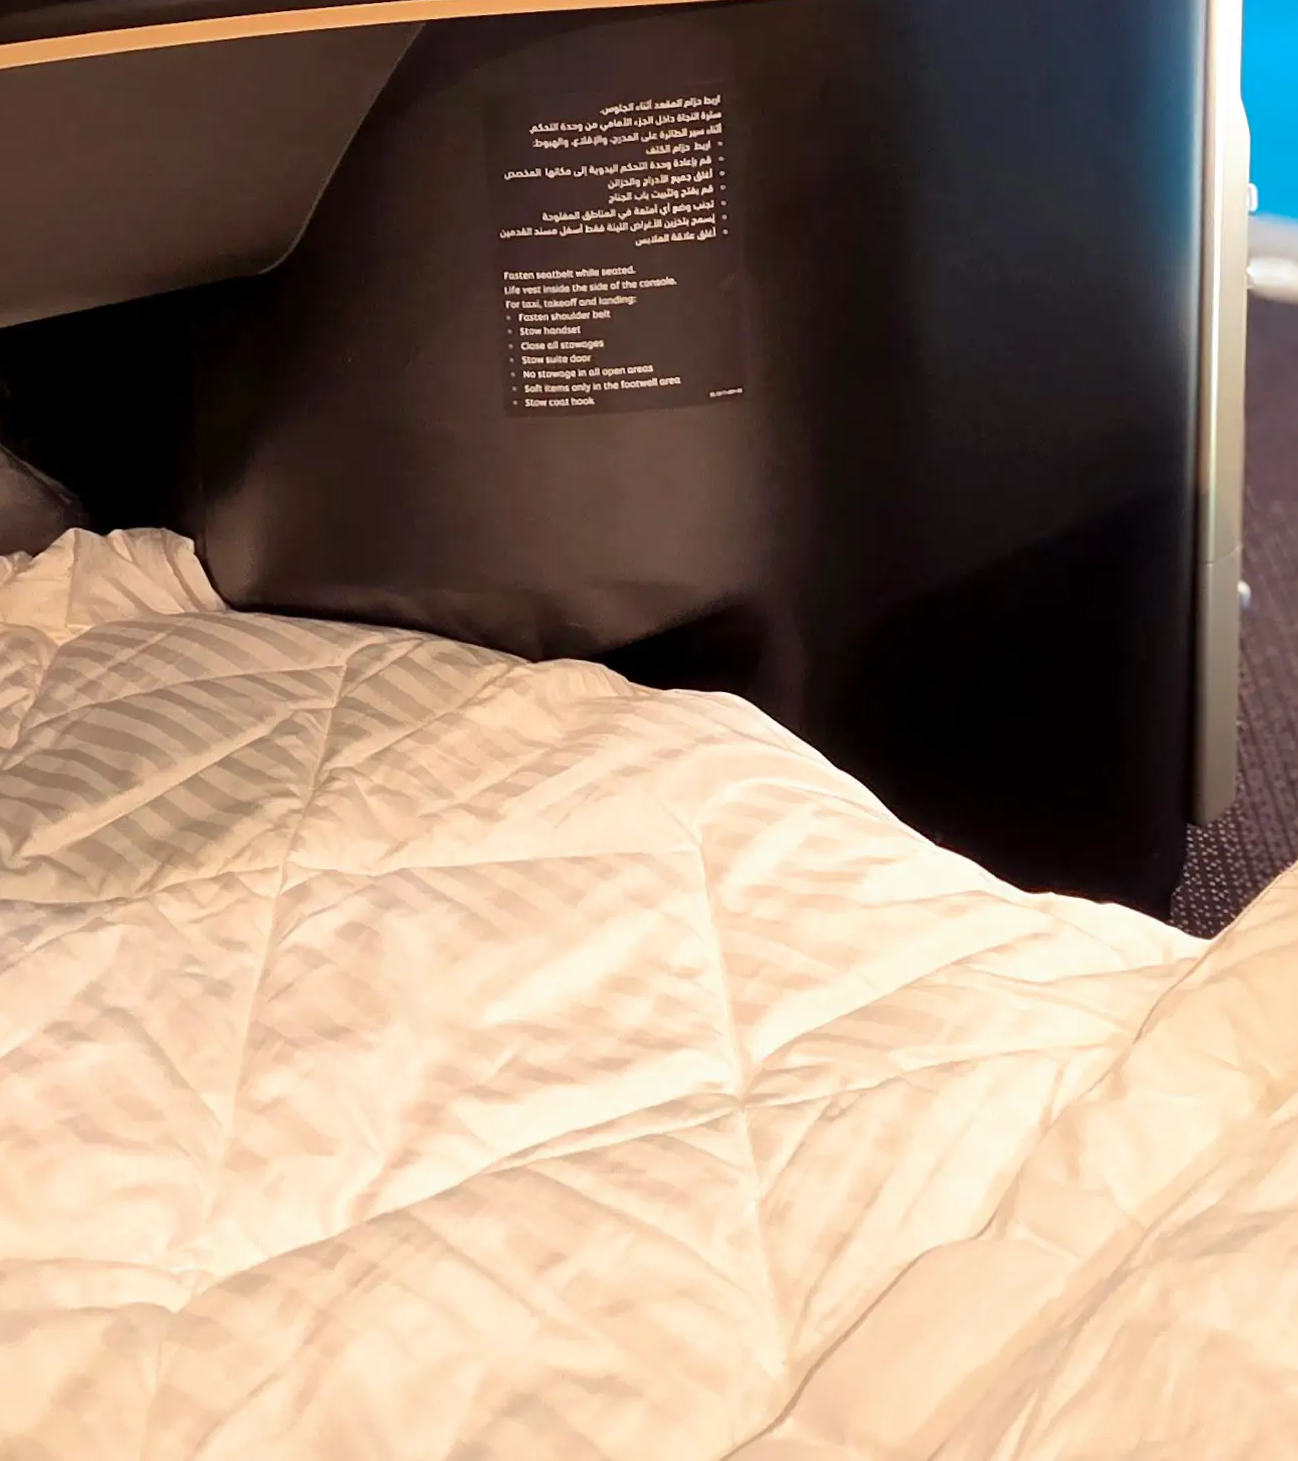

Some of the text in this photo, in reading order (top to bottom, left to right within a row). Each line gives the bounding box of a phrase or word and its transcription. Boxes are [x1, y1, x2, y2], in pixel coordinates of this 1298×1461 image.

[654, 99, 683, 109] المقعد
[684, 98, 702, 108] حزام
[634, 116, 653, 127] الجزء
[655, 115, 675, 126] داخل
[677, 112, 699, 122] النجاة
[560, 123, 583, 132] وحدة
[585, 123, 598, 131] من
[600, 118, 632, 131] الأمامي
[641, 131, 658, 142] على
[659, 128, 687, 140] الطائرة
[689, 129, 704, 138] سير
[672, 144, 690, 154] حزام
[650, 161, 671, 170] وحدة
[699, 155, 712, 166] قم
[545, 167, 571, 178] مكانها
[573, 166, 587, 177] إلى
[589, 164, 618, 175] اليدوية
[620, 162, 648, 174] التحكم
[504, 168, 541, 180] المخصص
[608, 168, 713, 189] أغلق جميع الأدراج والخزائن
[634, 191, 649, 200] باب
[681, 187, 699, 198] بفتح
[702, 185, 714, 195] قم
[542, 200, 714, 222] تجنب وضع أي أمتعة في المناطق المفتوحة
[585, 224, 605, 233] فقط
[630, 219, 662, 232] الأغراض
[664, 217, 689, 229] بتخزين
[500, 227, 532, 238] القدمين
[534, 227, 558, 235] مسند
[559, 223, 583, 236] أسفل
[635, 227, 716, 246] أغلق علاقة الملابس
[504, 266, 636, 280] Fasten seatbelt while seated.
[504, 276, 677, 295] Life vest inside the side of the console.
[506, 296, 636, 309] For taxi, takeoff and landing:
[519, 310, 611, 322] Fasten shoulder belt
[520, 326, 581, 335] Stow handset
[521, 340, 604, 350] Close all stowages
[522, 355, 591, 365] Stow suite door
[538, 370, 576, 379] stowage
[589, 368, 600, 376] all
[602, 367, 626, 377] open
[627, 365, 653, 374] areas
[524, 384, 542, 393] Soft
[571, 383, 591, 393] only
[604, 382, 619, 390] the
[621, 378, 658, 388] footwell
[659, 377, 681, 386] area
[525, 399, 547, 407] Stow
[571, 397, 595, 405] hook
